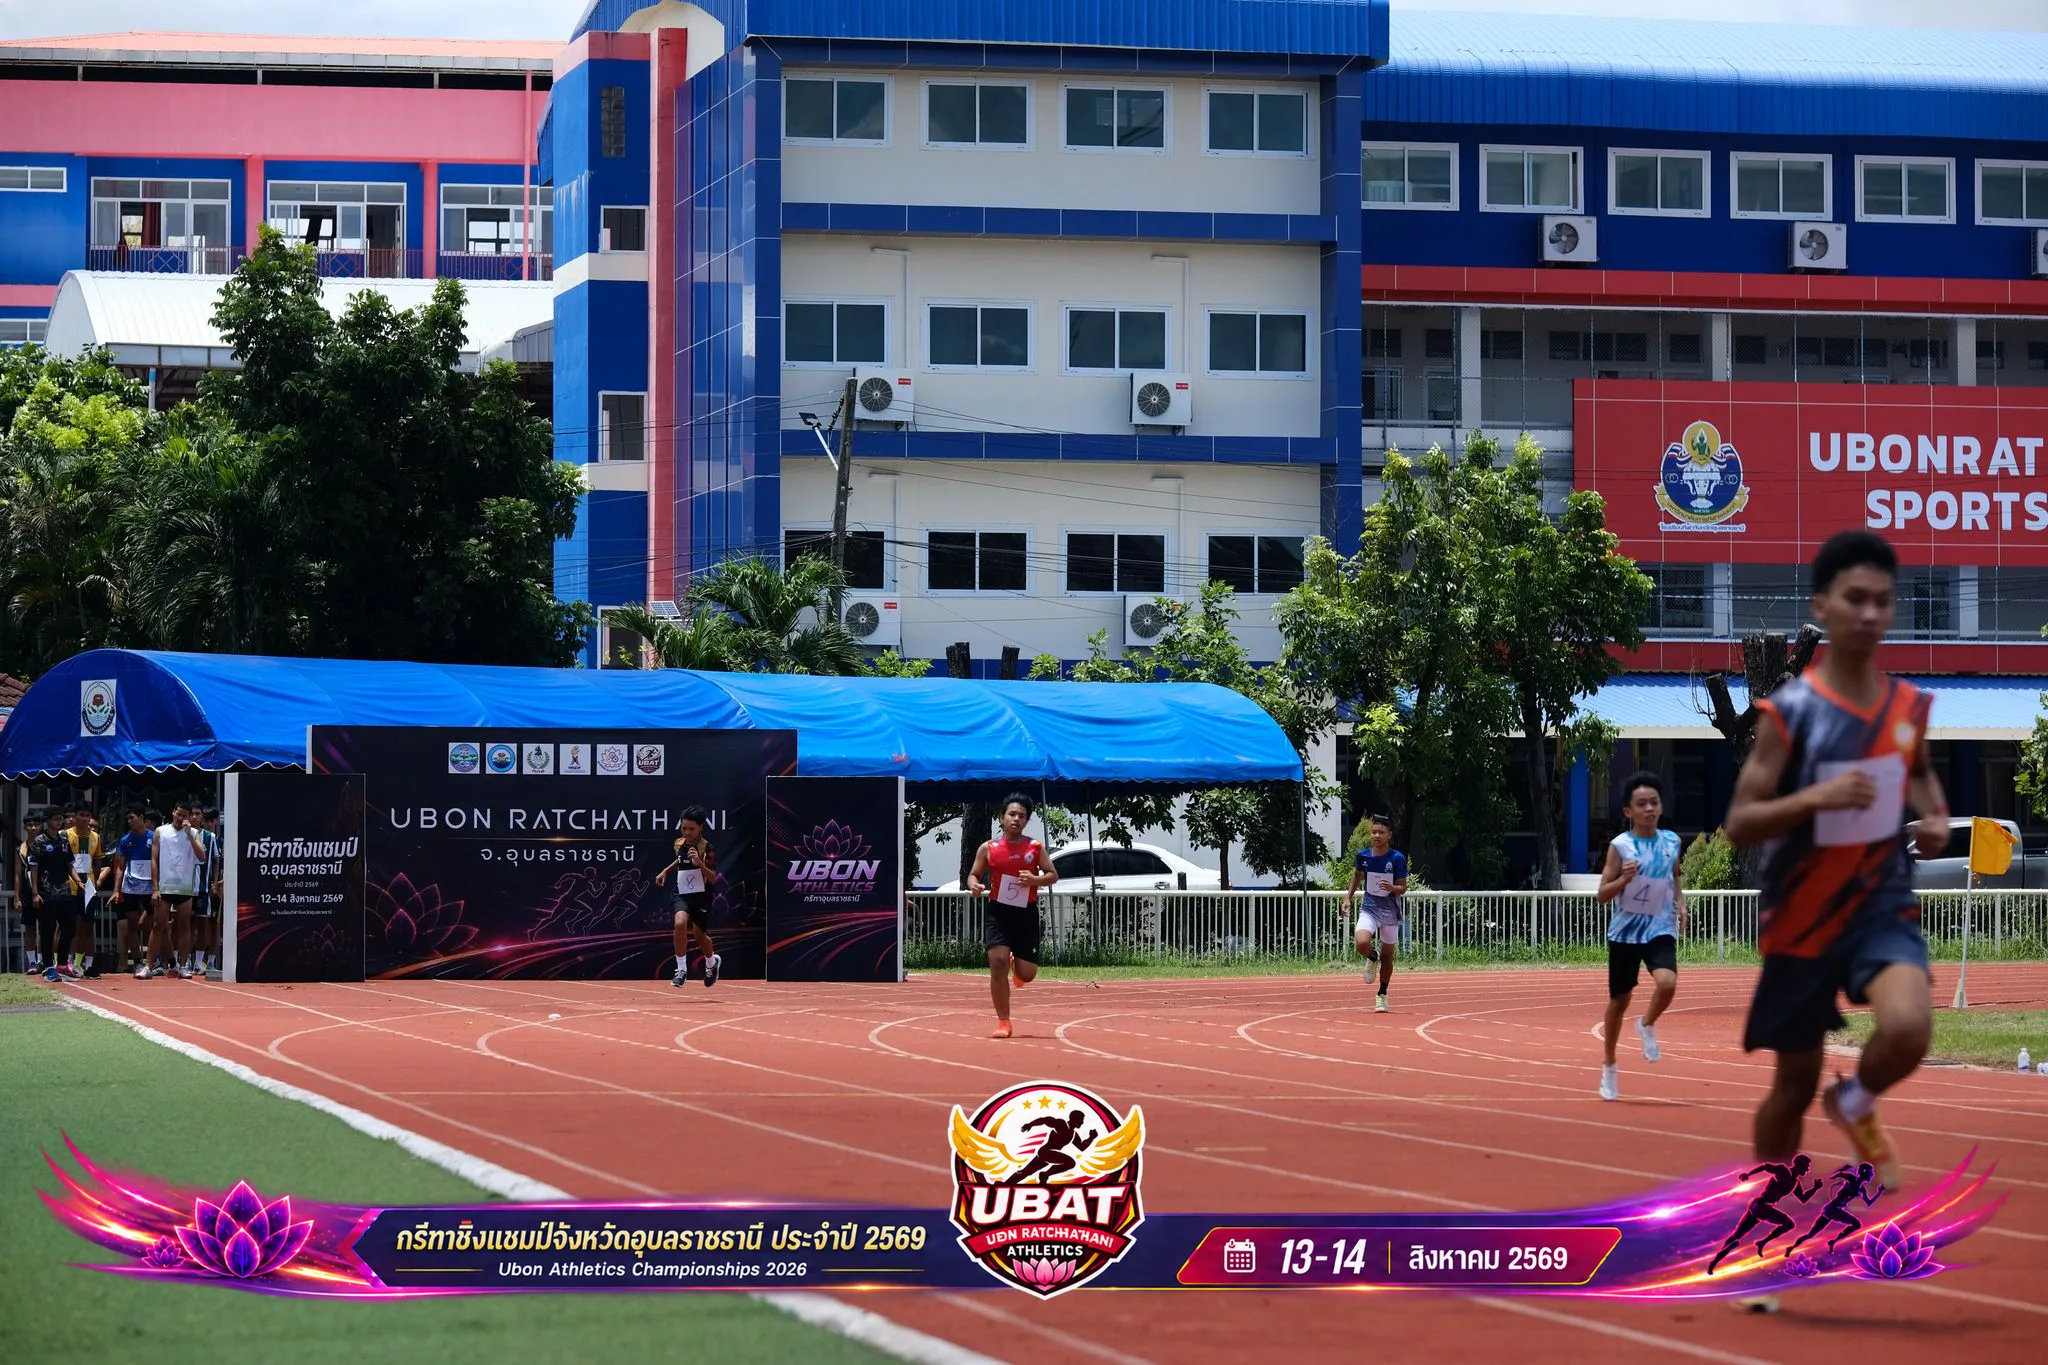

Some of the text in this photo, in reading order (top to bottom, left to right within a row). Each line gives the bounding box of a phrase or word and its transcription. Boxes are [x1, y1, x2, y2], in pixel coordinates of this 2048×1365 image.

[1809, 432, 2043, 476] UBONRAT
[1866, 489, 2048, 531] SPORTS
[391, 807, 726, 831] UBON RATCHATHNI
[174, 855, 182, 867] 2
[481, 845, 634, 866] จ.อุบลราชธานี
[260, 860, 343, 880] จ.อุบลราชธานี
[788, 860, 882, 880] UBON
[686, 874, 696, 890] 8
[791, 882, 876, 892] ATHLETICS
[1006, 882, 1020, 900] 5
[289, 894, 321, 904] สิงหาคม
[323, 894, 344, 903] 2569
[1632, 884, 1650, 907] 4
